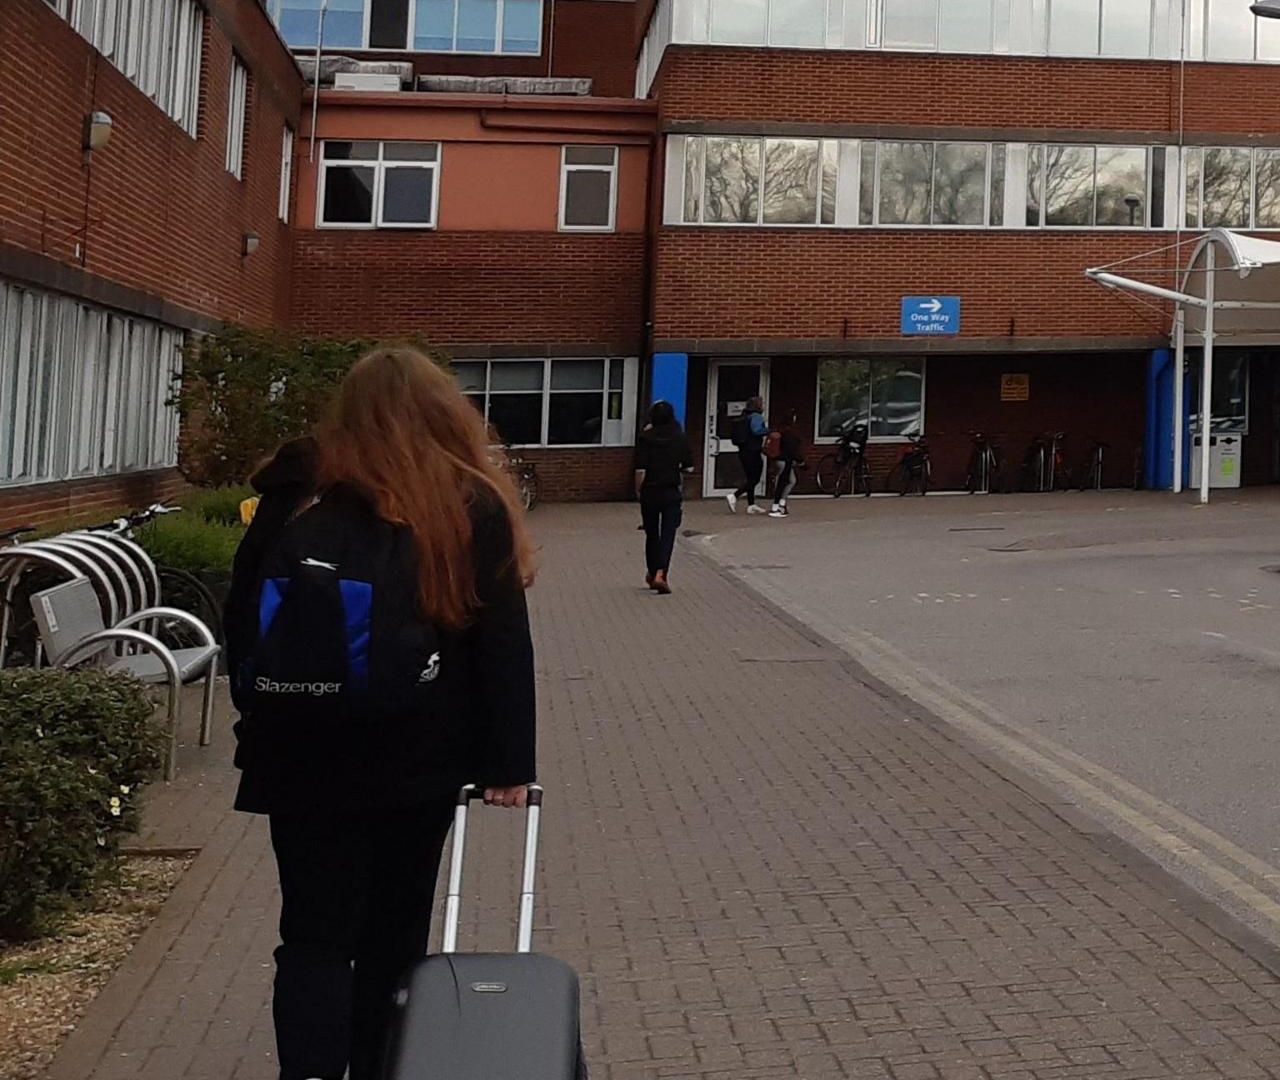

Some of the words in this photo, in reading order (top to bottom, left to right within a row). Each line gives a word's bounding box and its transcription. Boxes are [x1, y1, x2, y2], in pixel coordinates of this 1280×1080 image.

[910, 313, 929, 322] One
[930, 313, 950, 323] Way
[915, 323, 945, 332] Traffic
[254, 676, 342, 696] Slazenger
